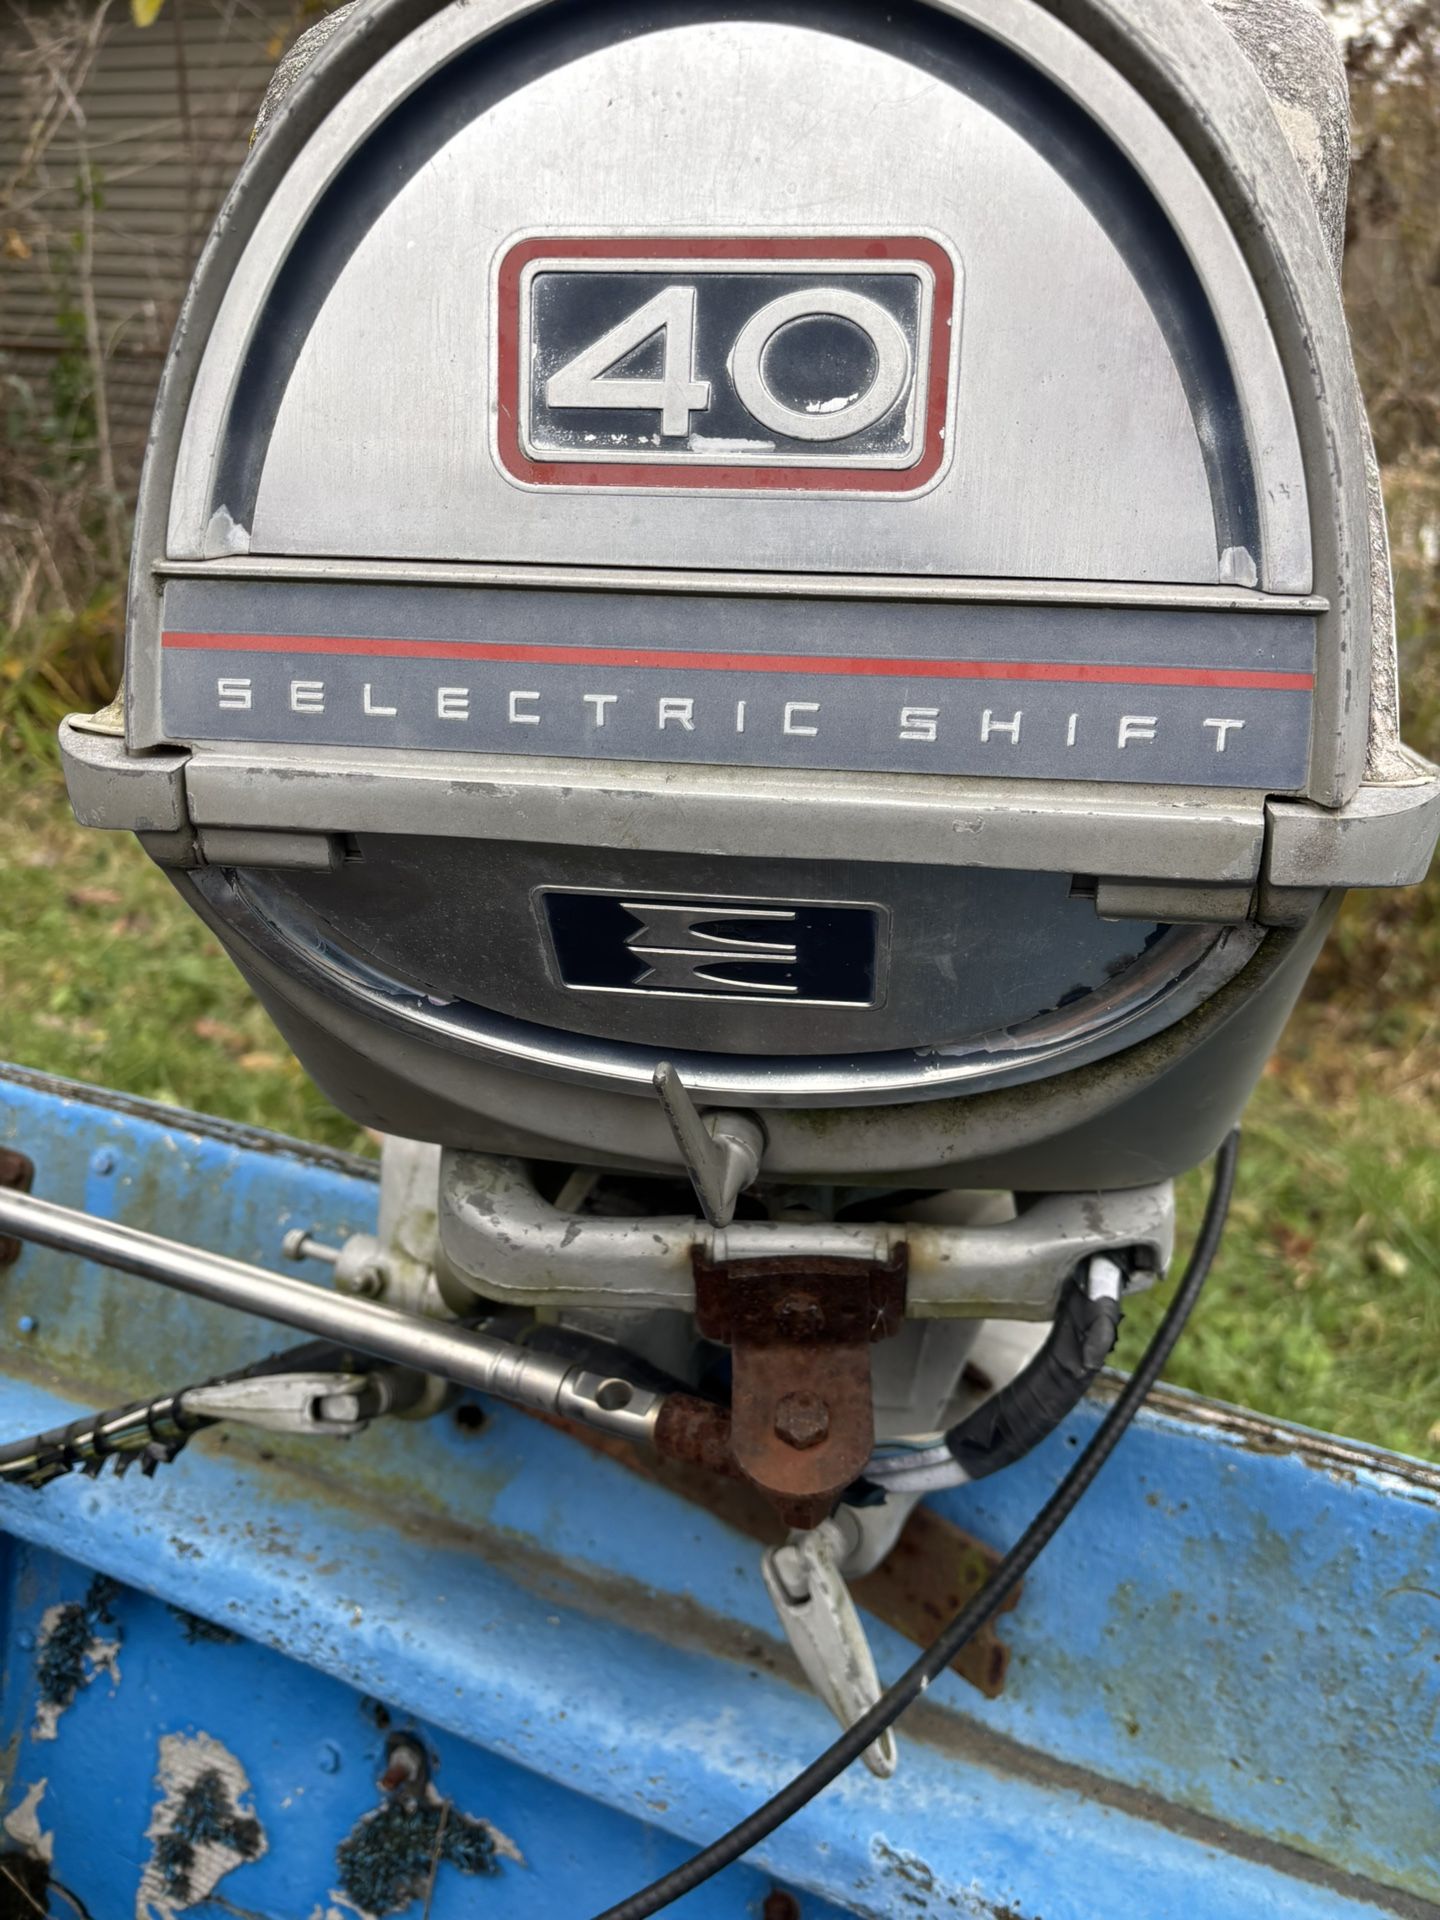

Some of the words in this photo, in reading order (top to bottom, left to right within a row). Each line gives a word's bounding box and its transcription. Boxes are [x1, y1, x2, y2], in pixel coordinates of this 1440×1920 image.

[546, 285, 911, 442] 40
[216, 678, 820, 737] SELECTRIC
[900, 706, 1245, 752] SHIFT
